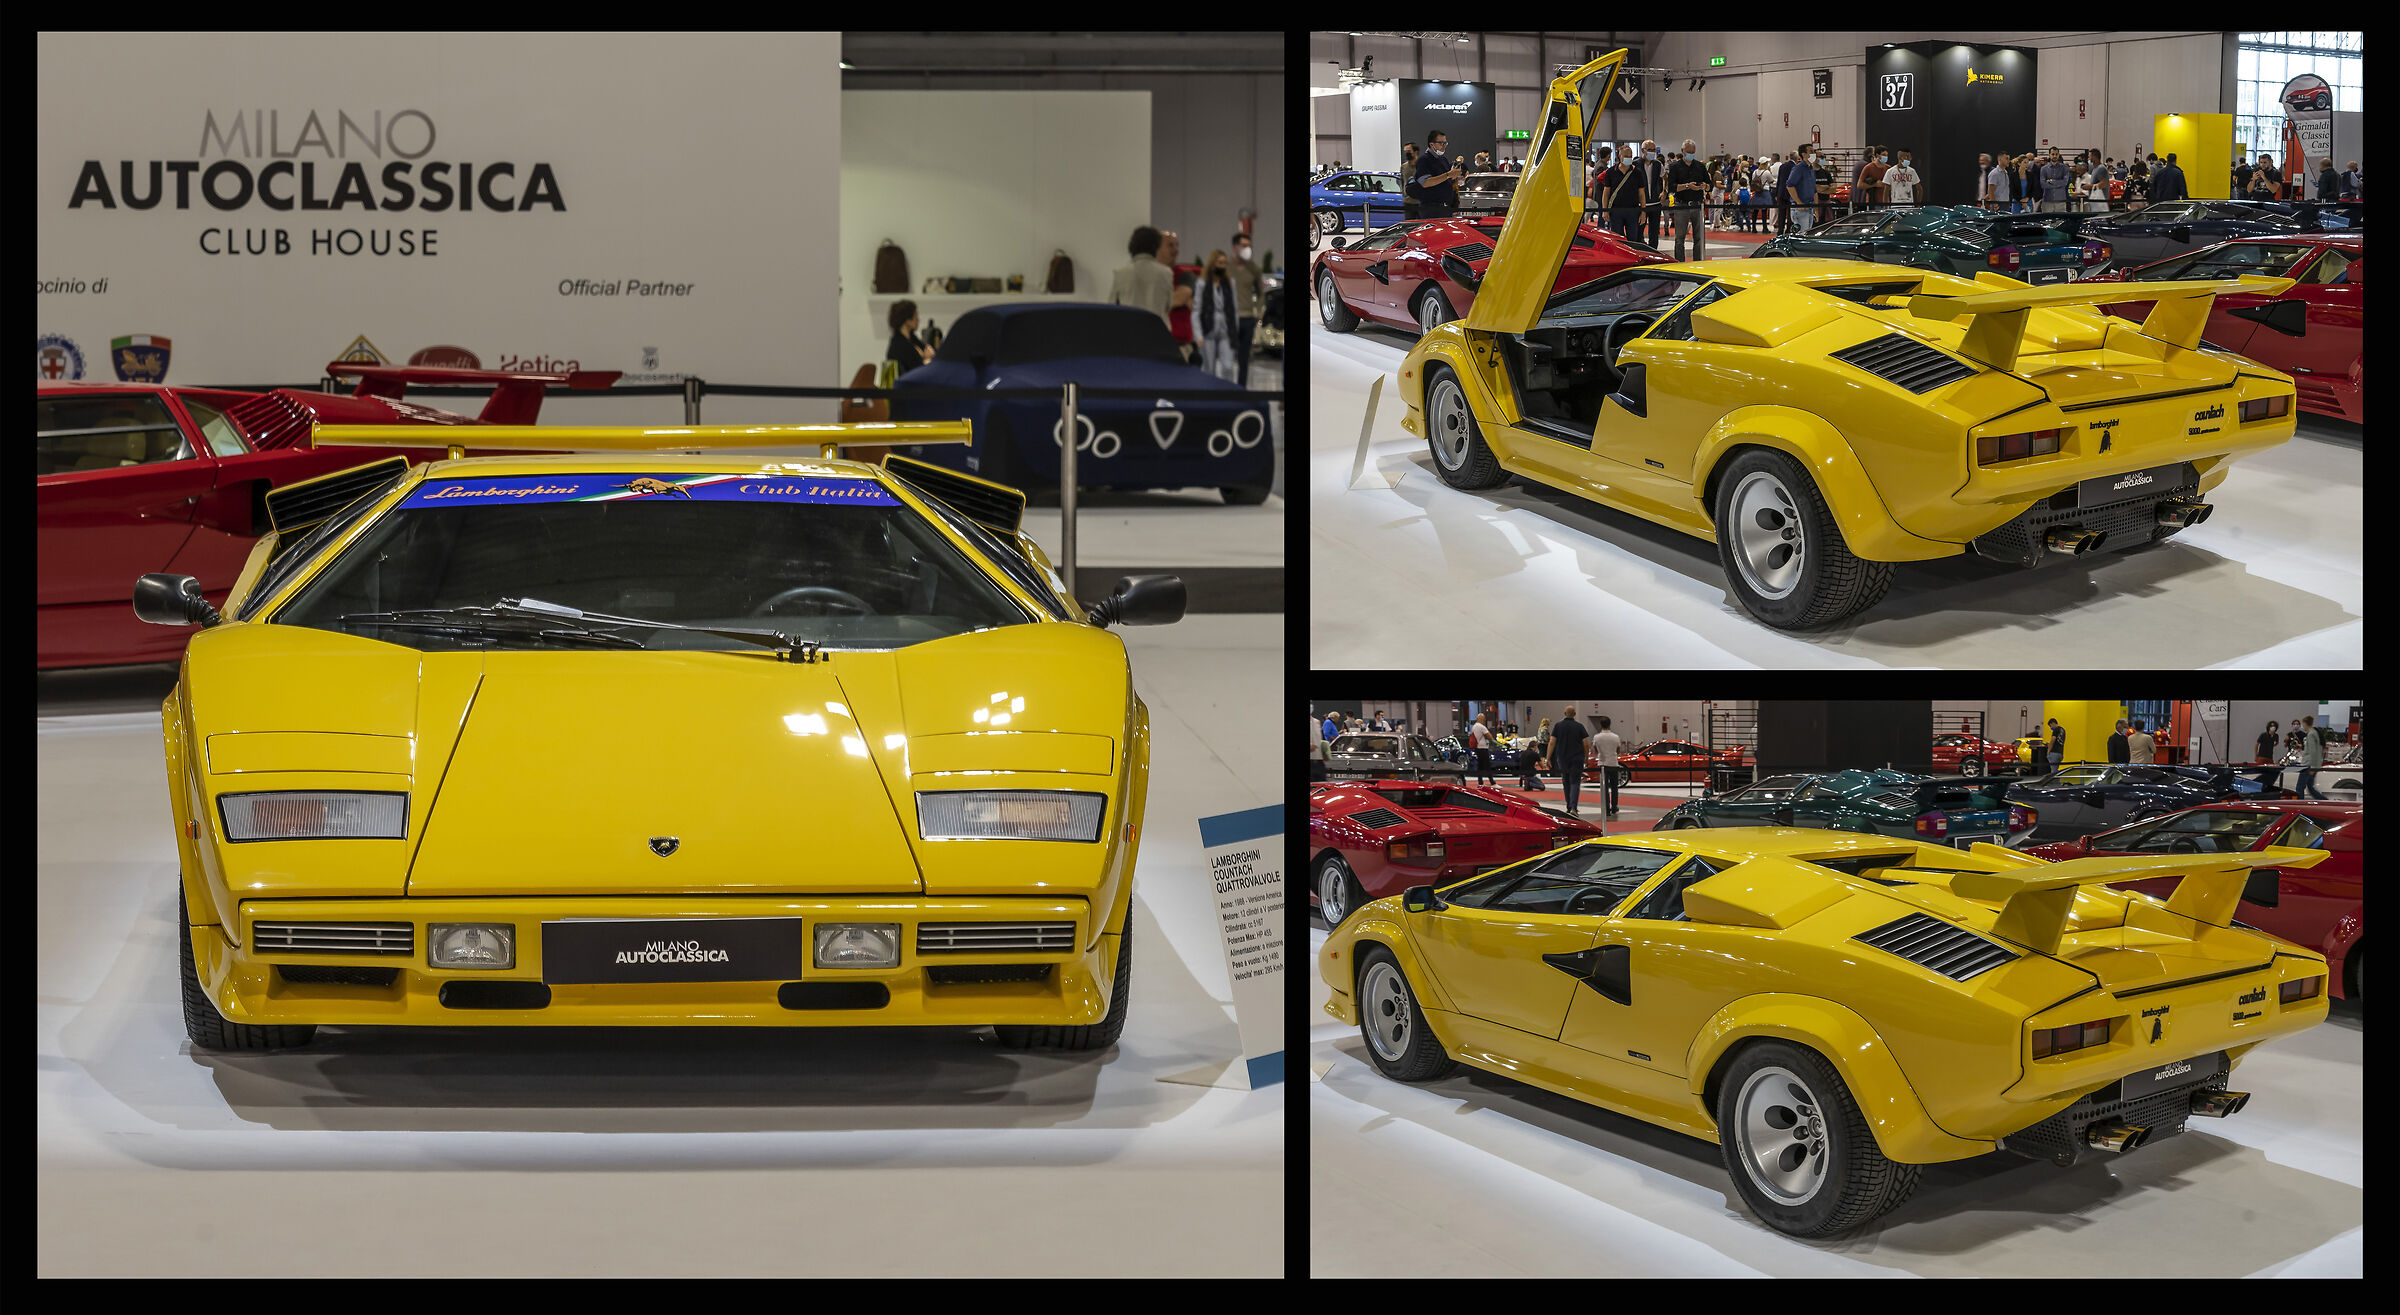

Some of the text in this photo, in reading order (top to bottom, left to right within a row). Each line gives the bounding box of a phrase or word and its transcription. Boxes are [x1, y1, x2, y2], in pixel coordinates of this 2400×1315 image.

[1885, 75, 1908, 84] EVO
[1815, 83, 1827, 95] 15
[1885, 83, 1908, 108] 37
[199, 108, 437, 160] MILANO
[2295, 121, 2330, 131] Grimaldi
[2301, 131, 2330, 140] Classic
[2312, 140, 2330, 149] Cars
[68, 160, 567, 212] AUTOCLASSICA
[199, 228, 439, 257] CLUB HOUSE
[92, 277, 108, 294] di
[558, 278, 695, 296] Official Partner
[2194, 403, 2225, 422] countach
[2113, 475, 2153, 491] AUTOCLASSICA
[2123, 471, 2144, 482] MILANO
[423, 484, 580, 499] Lamborghini
[739, 484, 882, 498] Club Italia
[2208, 702, 2227, 712] Cars
[1210, 849, 1262, 869] LAMBORGHINI
[1213, 863, 1254, 881] COUNTACH
[1216, 870, 1281, 894] QUATTROVALVOLE
[645, 940, 700, 952] MILANO
[615, 949, 729, 964] AUTOCLASSICA
[2154, 1064, 2192, 1081] AUTOCLASSICA
